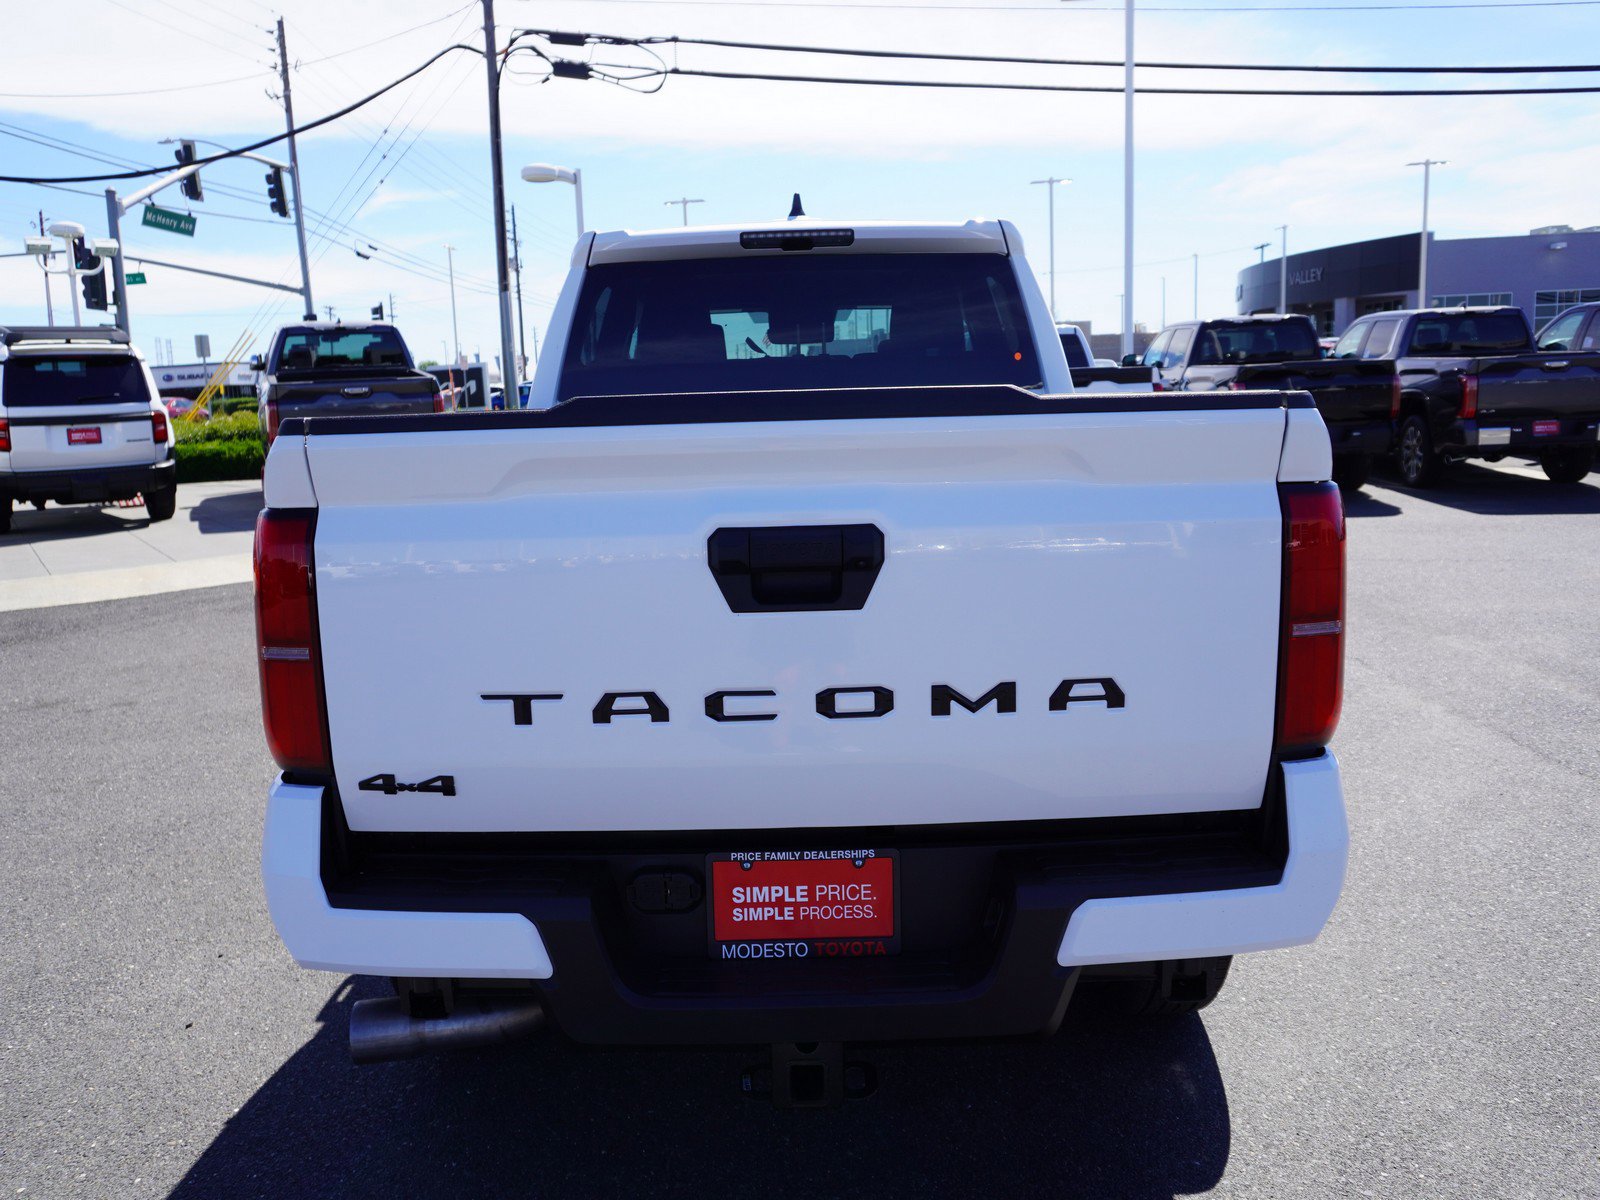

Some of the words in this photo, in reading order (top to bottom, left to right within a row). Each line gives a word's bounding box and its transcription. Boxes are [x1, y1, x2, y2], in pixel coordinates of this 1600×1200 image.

[145, 211, 178, 229] McHenry
[180, 221, 193, 231] Ave
[1288, 267, 1324, 285] VALLEY
[480, 677, 1125, 726] TACOMA
[730, 852, 761, 861] PRICE
[764, 851, 800, 861] FAMILY
[804, 849, 875, 860] DEALERSHIPS
[732, 885, 809, 904] SIMPLE
[815, 884, 877, 901] PRICE.
[732, 907, 794, 922] SIMPLE
[799, 904, 878, 920] PROCESS.
[721, 942, 808, 959] MODESTO
[814, 941, 887, 957] TOYOTA
